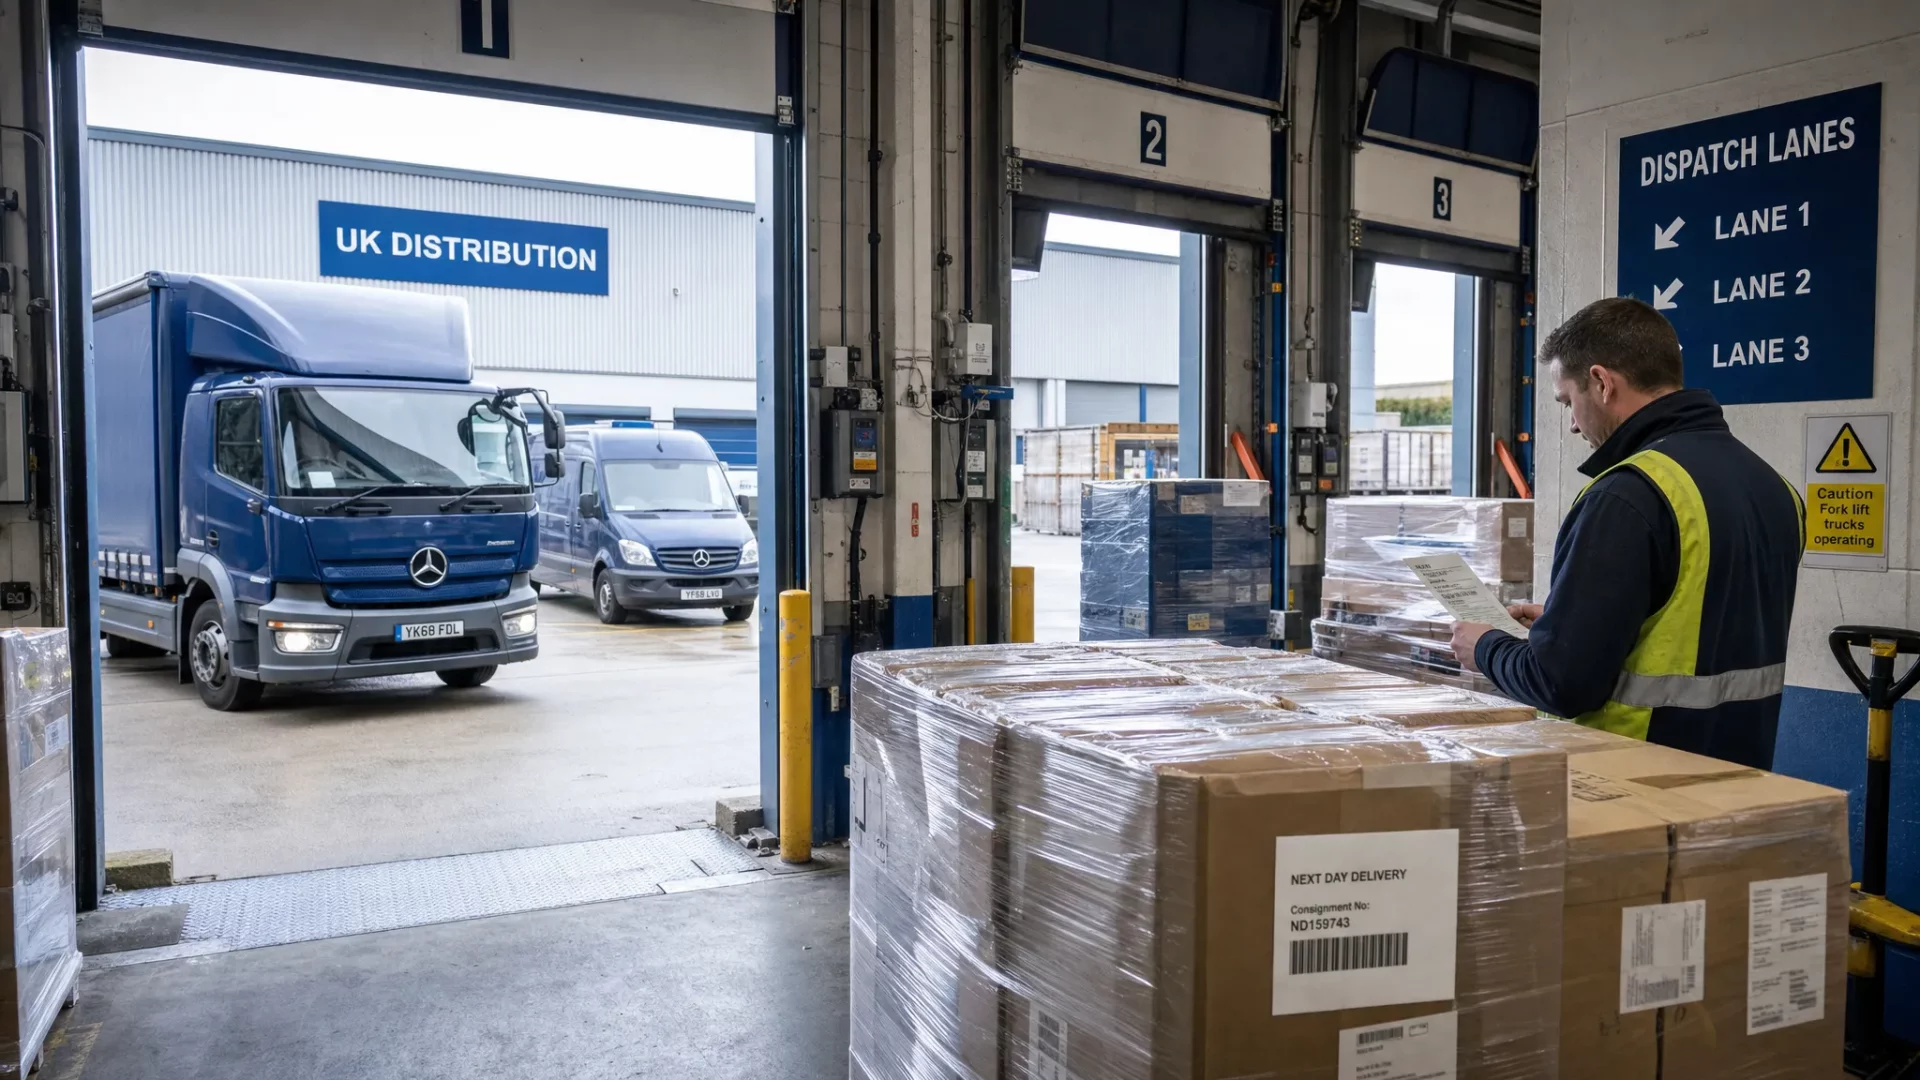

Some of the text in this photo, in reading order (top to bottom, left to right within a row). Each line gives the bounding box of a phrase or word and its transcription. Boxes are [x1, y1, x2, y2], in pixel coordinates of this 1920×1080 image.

[1145, 119, 1162, 160] 2
[1641, 116, 1855, 187] DISPATCH LANES
[1437, 182, 1449, 217] 3
[1715, 201, 1810, 240] LANE 1
[336, 226, 597, 272] UK DISTRIBUTION
[1713, 268, 1811, 304] LANE 2
[1713, 335, 1810, 368] LANE 3
[1817, 488, 1873, 500] Caution
[1820, 503, 1870, 515] Fork lift
[1824, 519, 1865, 530] trucks
[1814, 535, 1875, 548] operating
[405, 624, 460, 638] YK68 FDL
[1291, 869, 1407, 885] NEXT DAY DELIVERY
[1290, 901, 1370, 915] Consignment No:
[1290, 917, 1351, 932] ND159743
